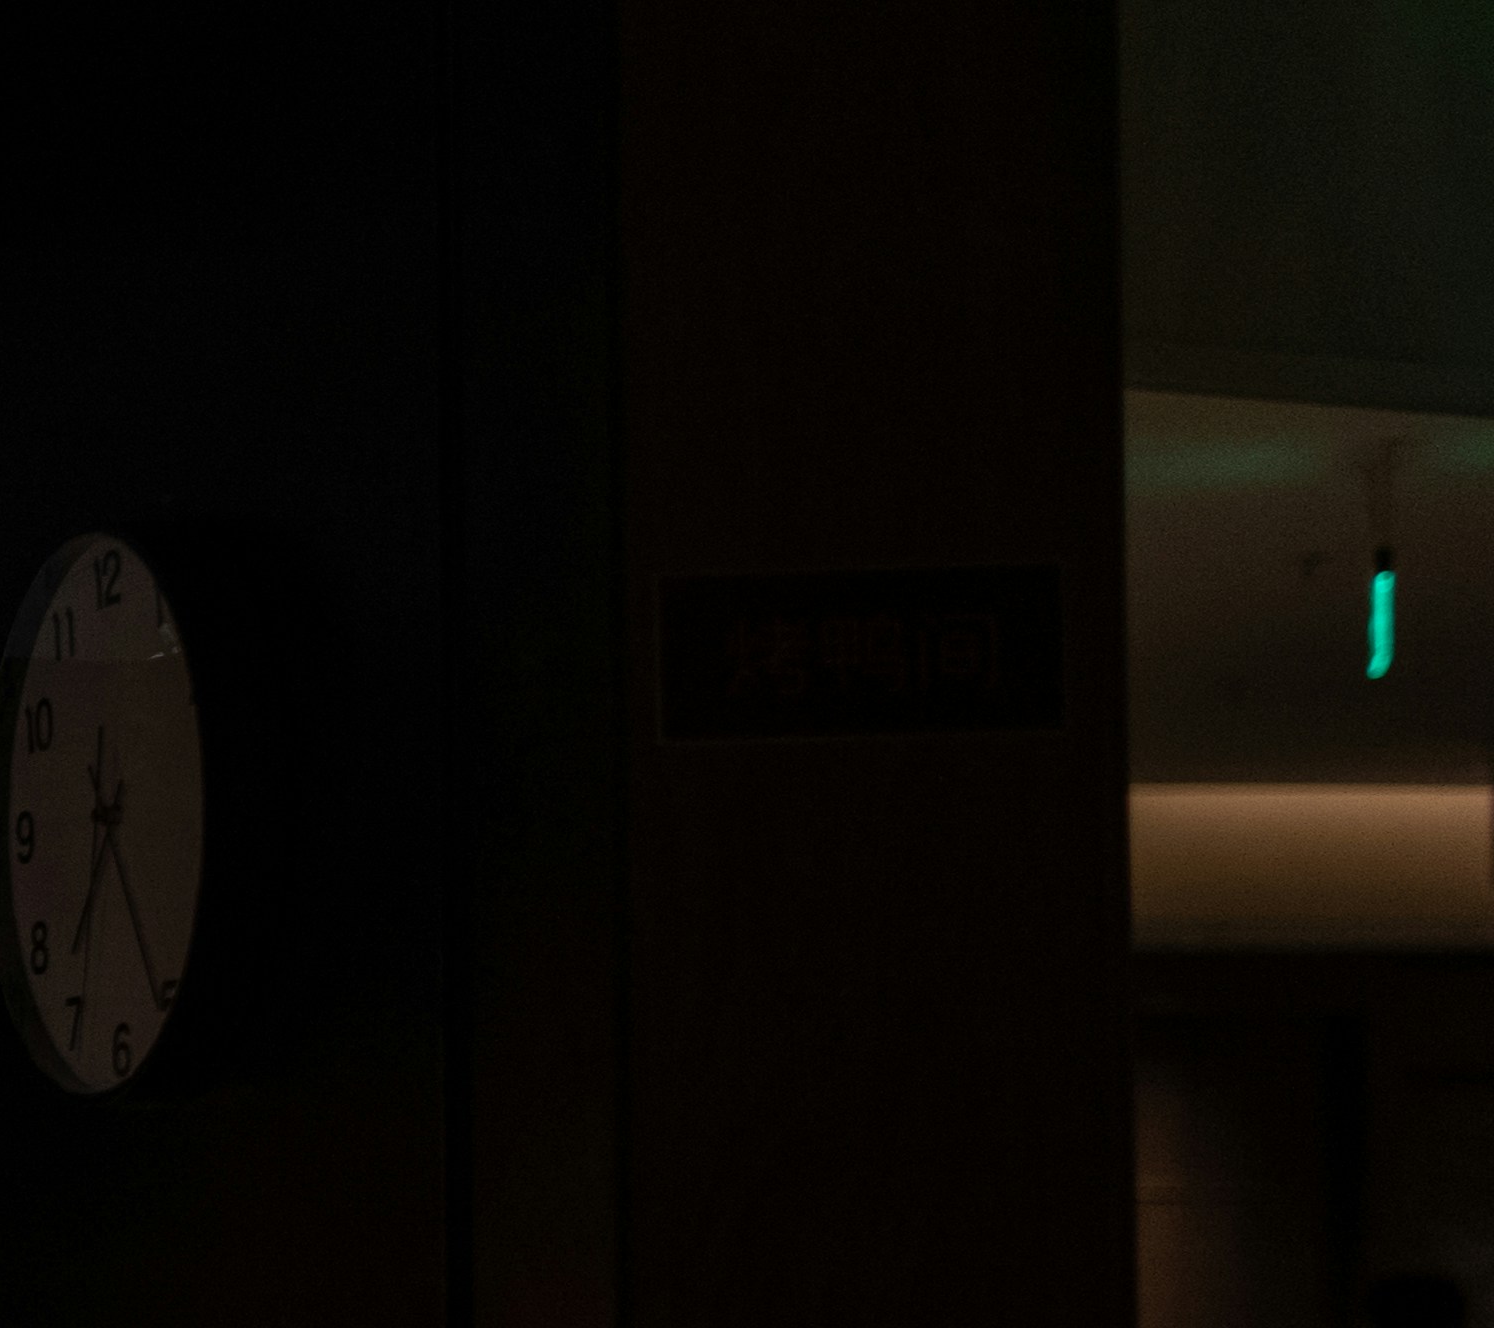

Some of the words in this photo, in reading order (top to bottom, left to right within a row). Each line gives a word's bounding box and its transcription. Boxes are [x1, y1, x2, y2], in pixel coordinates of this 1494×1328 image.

[92, 548, 122, 610] 12
[51, 606, 76, 662] 11
[725, 611, 1000, 697] 烤鸭间
[25, 697, 54, 754] 10
[15, 810, 35, 864] 9
[29, 920, 49, 975] 8
[65, 995, 84, 1052] 7
[111, 1022, 131, 1077] 6
